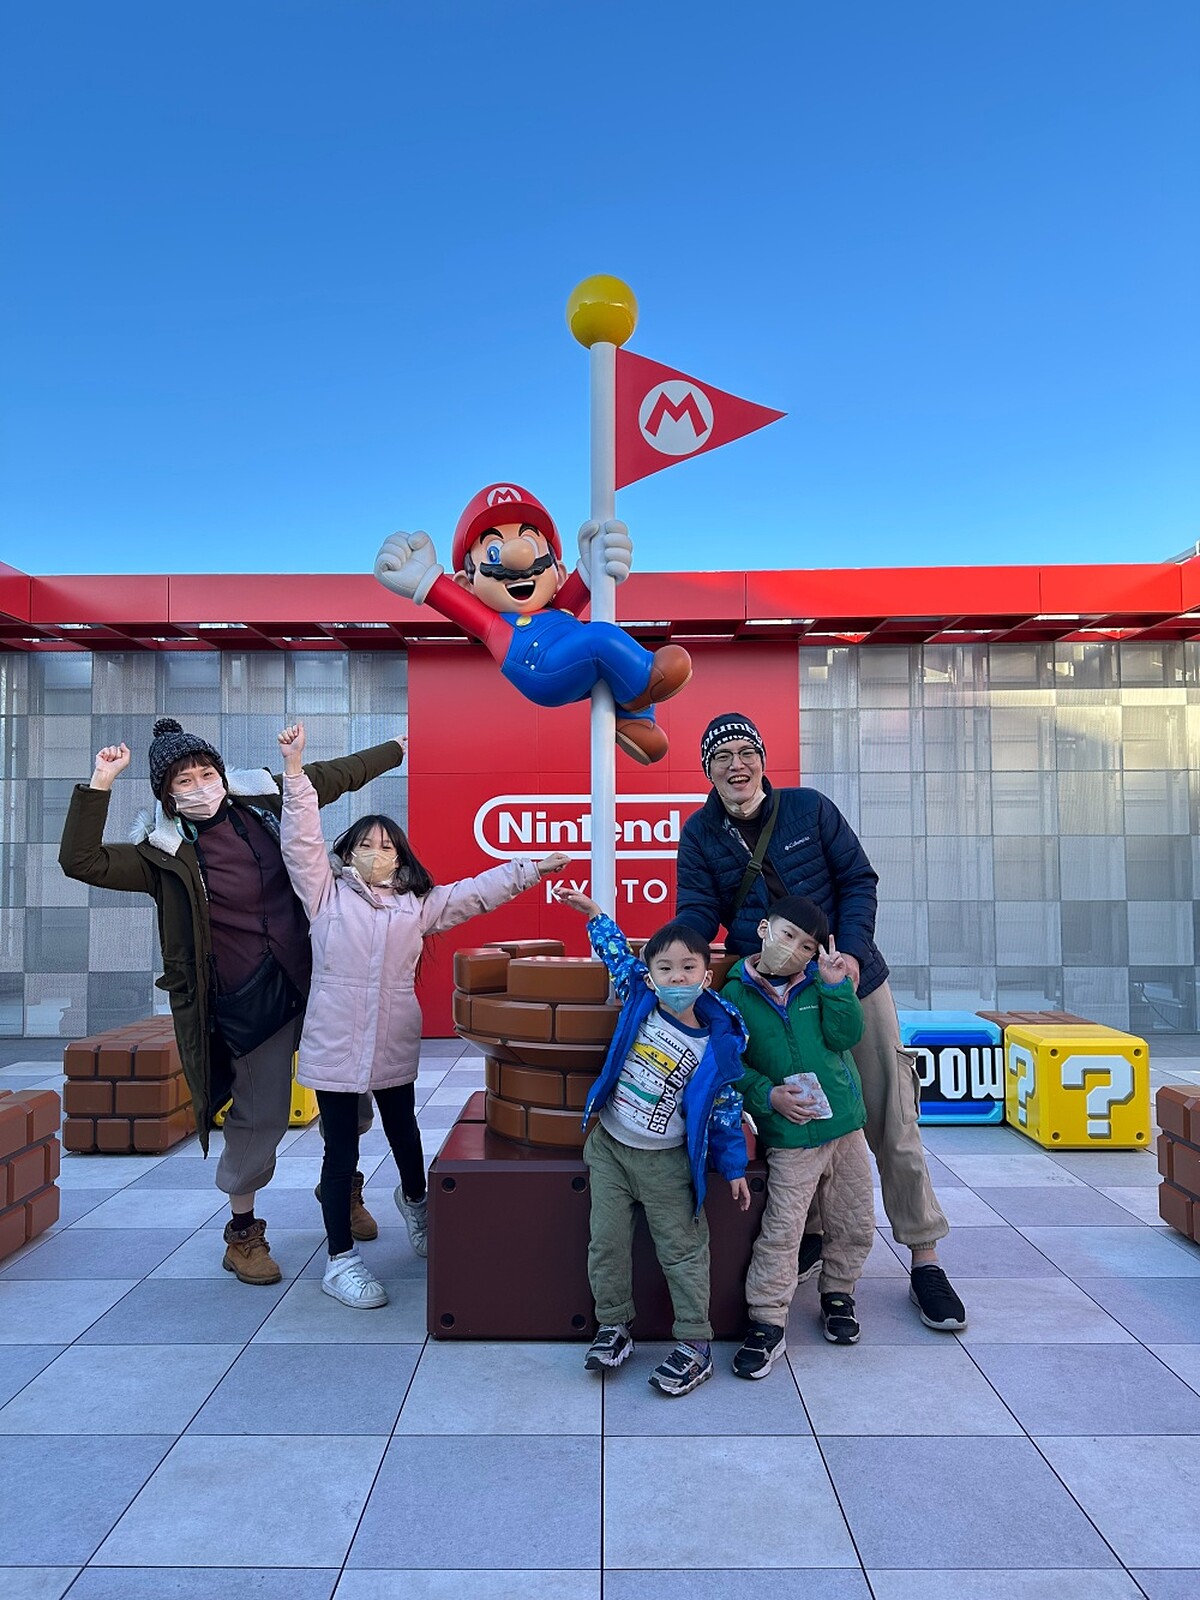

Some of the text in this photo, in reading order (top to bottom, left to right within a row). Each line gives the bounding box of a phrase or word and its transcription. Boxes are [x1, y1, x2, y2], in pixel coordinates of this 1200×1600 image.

[644, 391, 708, 438] M
[491, 489, 520, 506] M
[499, 810, 680, 842] Nintnd
[546, 879, 668, 904] KYTO
[668, 1050, 698, 1088] SUPER
[904, 1047, 1004, 1099] POW
[1009, 1042, 1035, 1128] ?
[650, 1084, 677, 1133] EXPRESS
[1061, 1055, 1135, 1139] ?
